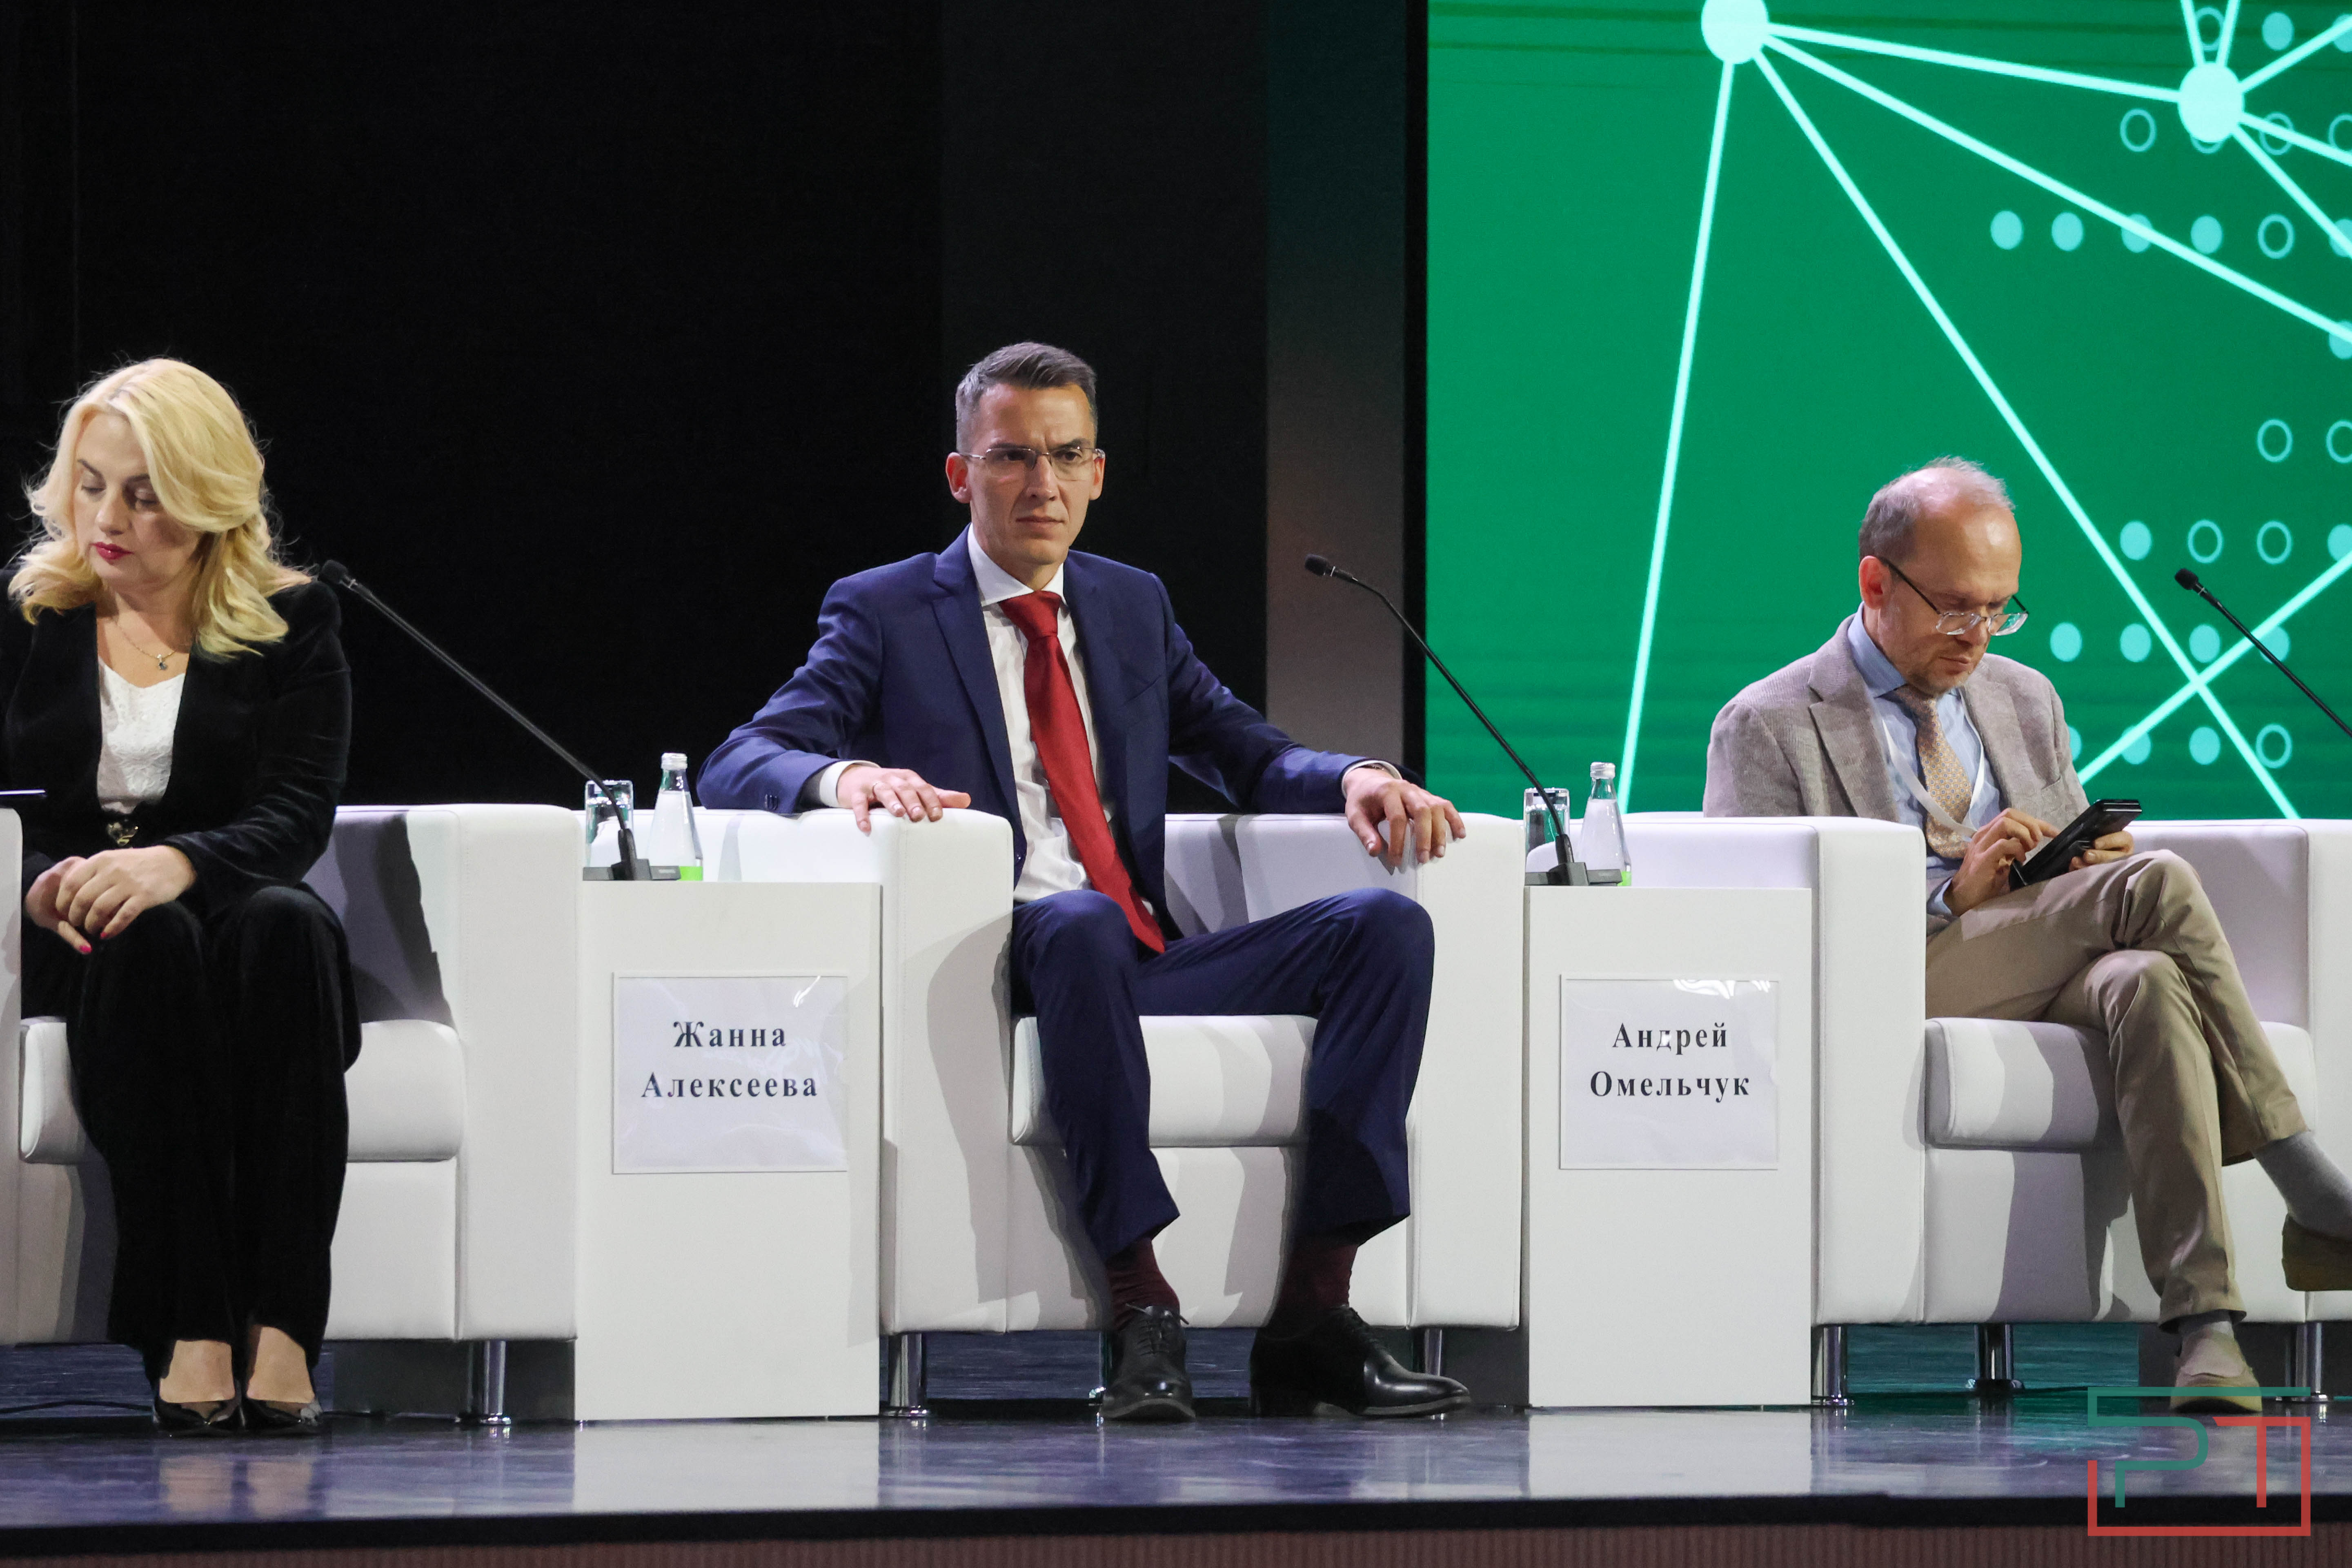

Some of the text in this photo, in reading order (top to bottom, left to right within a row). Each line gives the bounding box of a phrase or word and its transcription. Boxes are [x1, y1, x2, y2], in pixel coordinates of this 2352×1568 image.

[673, 1021, 786, 1048] Жанна
[1612, 1022, 1727, 1055] Андрей
[641, 1072, 818, 1098] Алексеева
[1590, 1071, 1749, 1103] Омельчук
